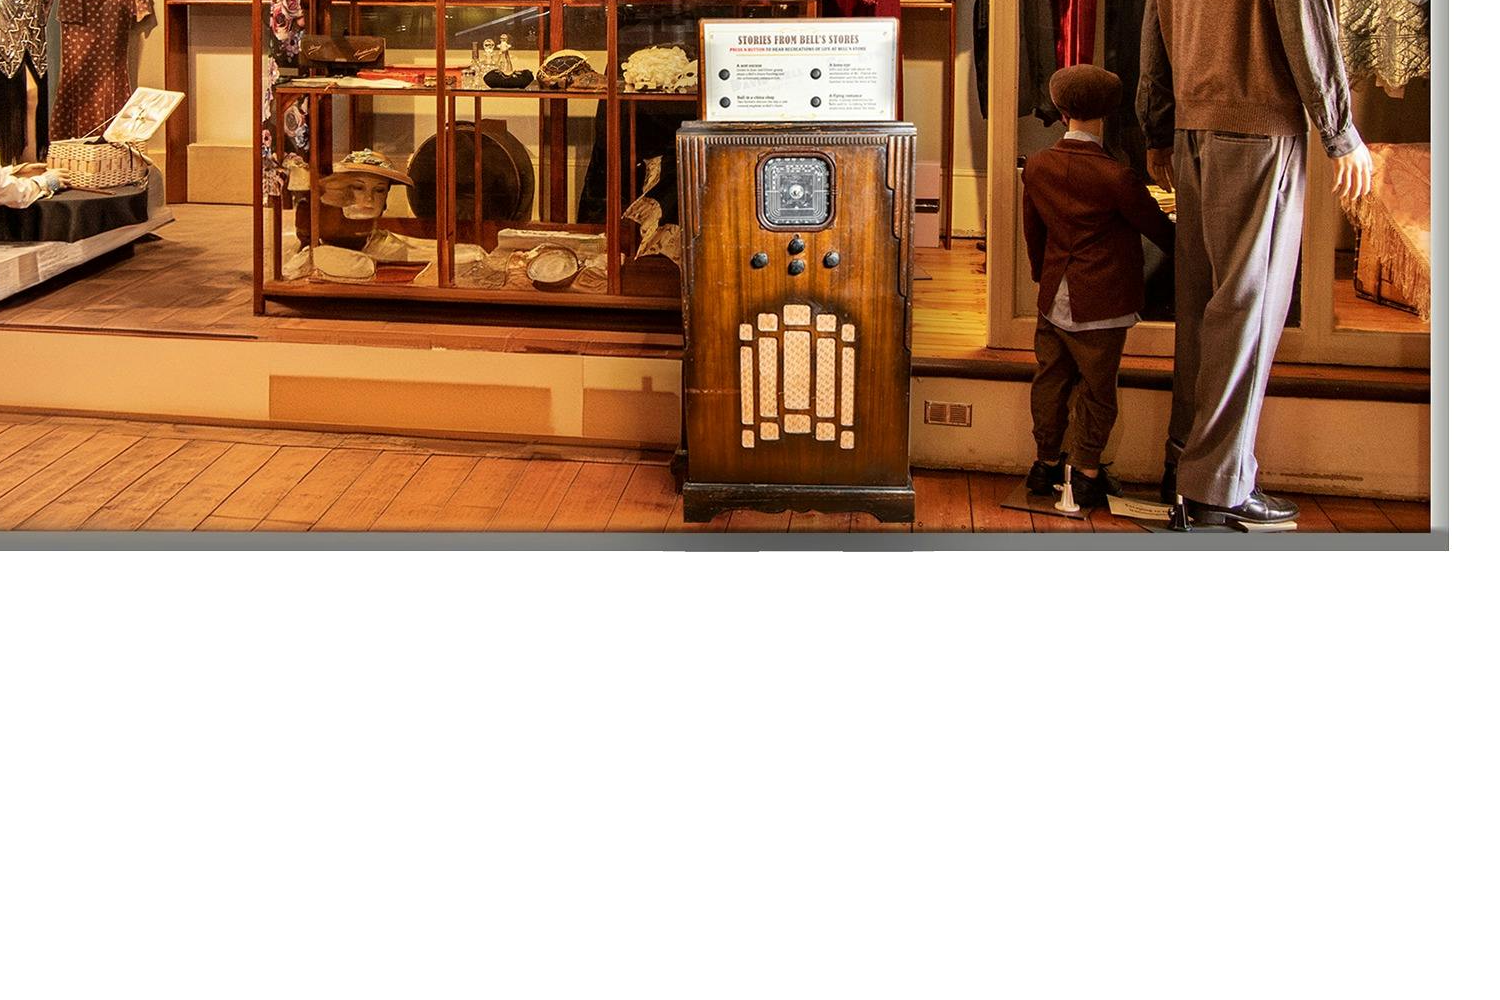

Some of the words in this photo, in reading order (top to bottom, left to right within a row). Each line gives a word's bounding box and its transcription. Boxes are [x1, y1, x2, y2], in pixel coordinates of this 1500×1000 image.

[738, 35, 772, 45] STORIES
[774, 35, 797, 45] FROM
[800, 35, 826, 45] BELL'S
[829, 34, 860, 45] STORES
